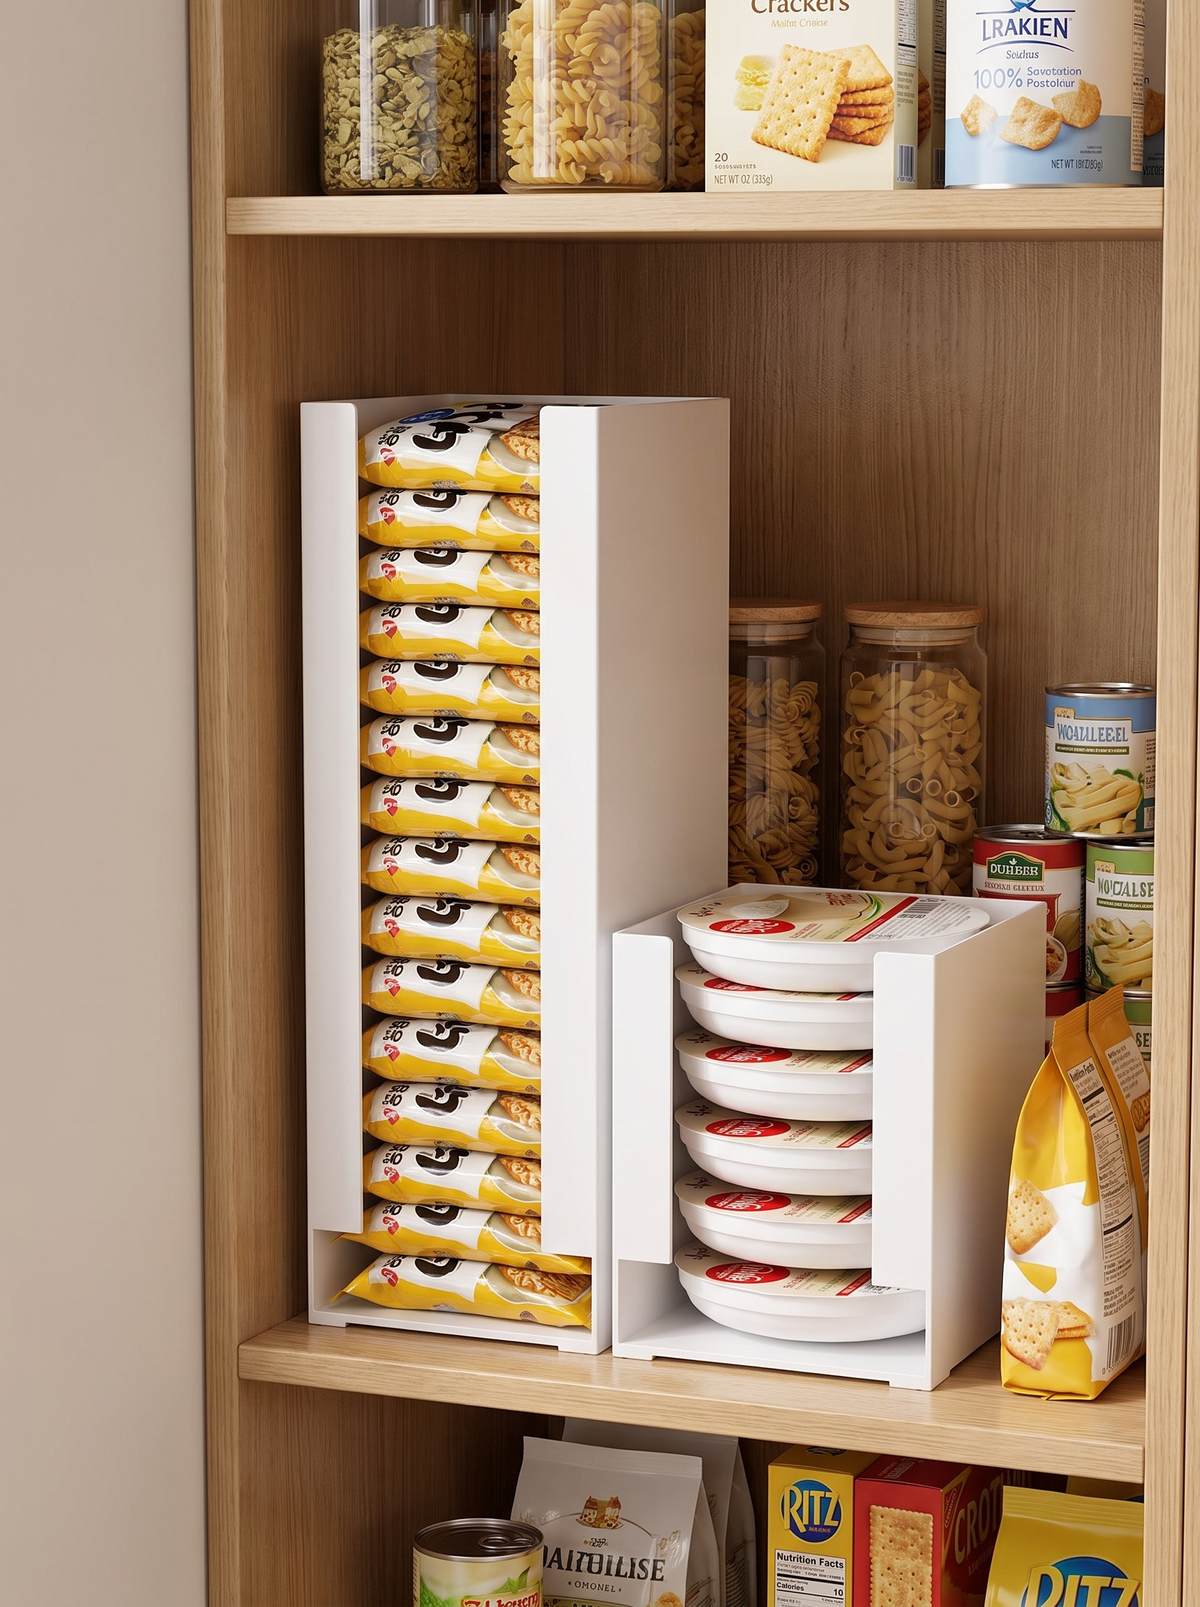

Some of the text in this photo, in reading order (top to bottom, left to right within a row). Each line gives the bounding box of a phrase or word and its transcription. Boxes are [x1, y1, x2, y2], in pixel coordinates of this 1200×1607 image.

[751, 0, 850, 14] Crackers
[974, 67, 1023, 89] 100%
[714, 152, 729, 163] 20
[1051, 159, 1064, 169] NET
[1064, 159, 1074, 169] WT
[714, 174, 727, 184] NET
[728, 174, 739, 184] WT
[783, 1484, 840, 1534] RITZ
[777, 1552, 817, 1566] Nutrition
[819, 1558, 844, 1569] Facts
[776, 1581, 805, 1592] Calories
[833, 1588, 844, 1597] 10
